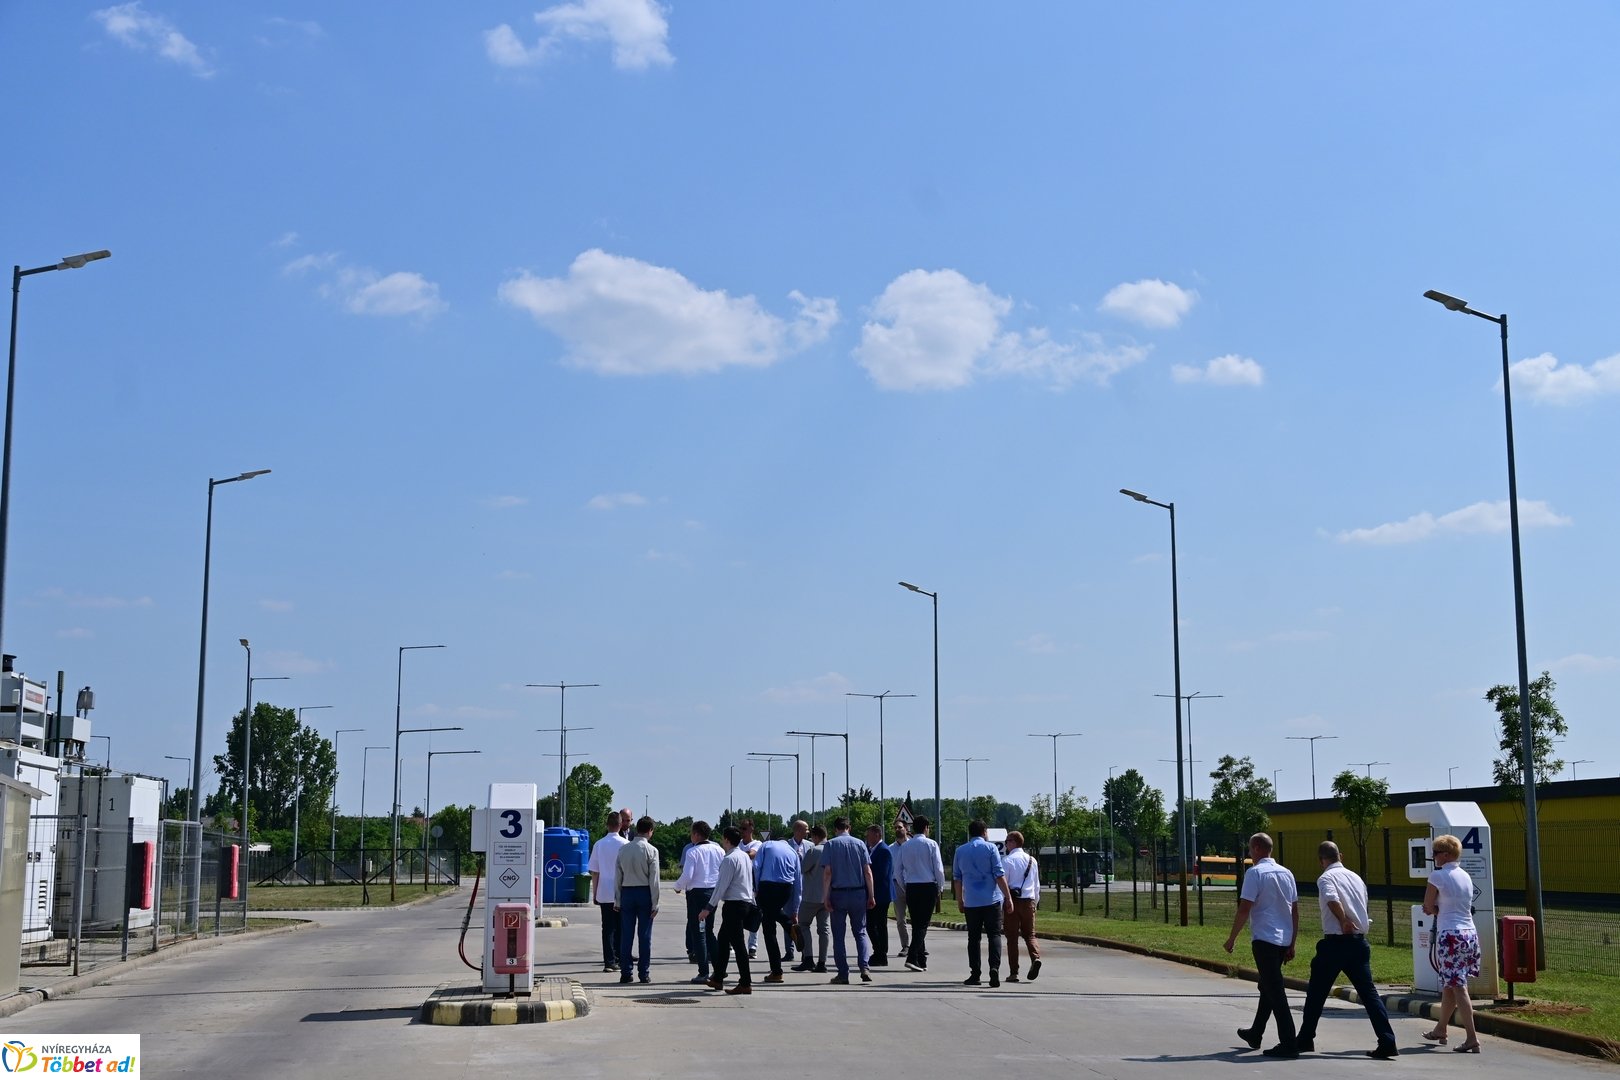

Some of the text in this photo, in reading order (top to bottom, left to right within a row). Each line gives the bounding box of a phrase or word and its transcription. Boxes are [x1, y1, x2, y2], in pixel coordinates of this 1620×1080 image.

[108, 797, 115, 811] 1
[499, 809, 523, 838] 3
[1461, 827, 1483, 854] 4
